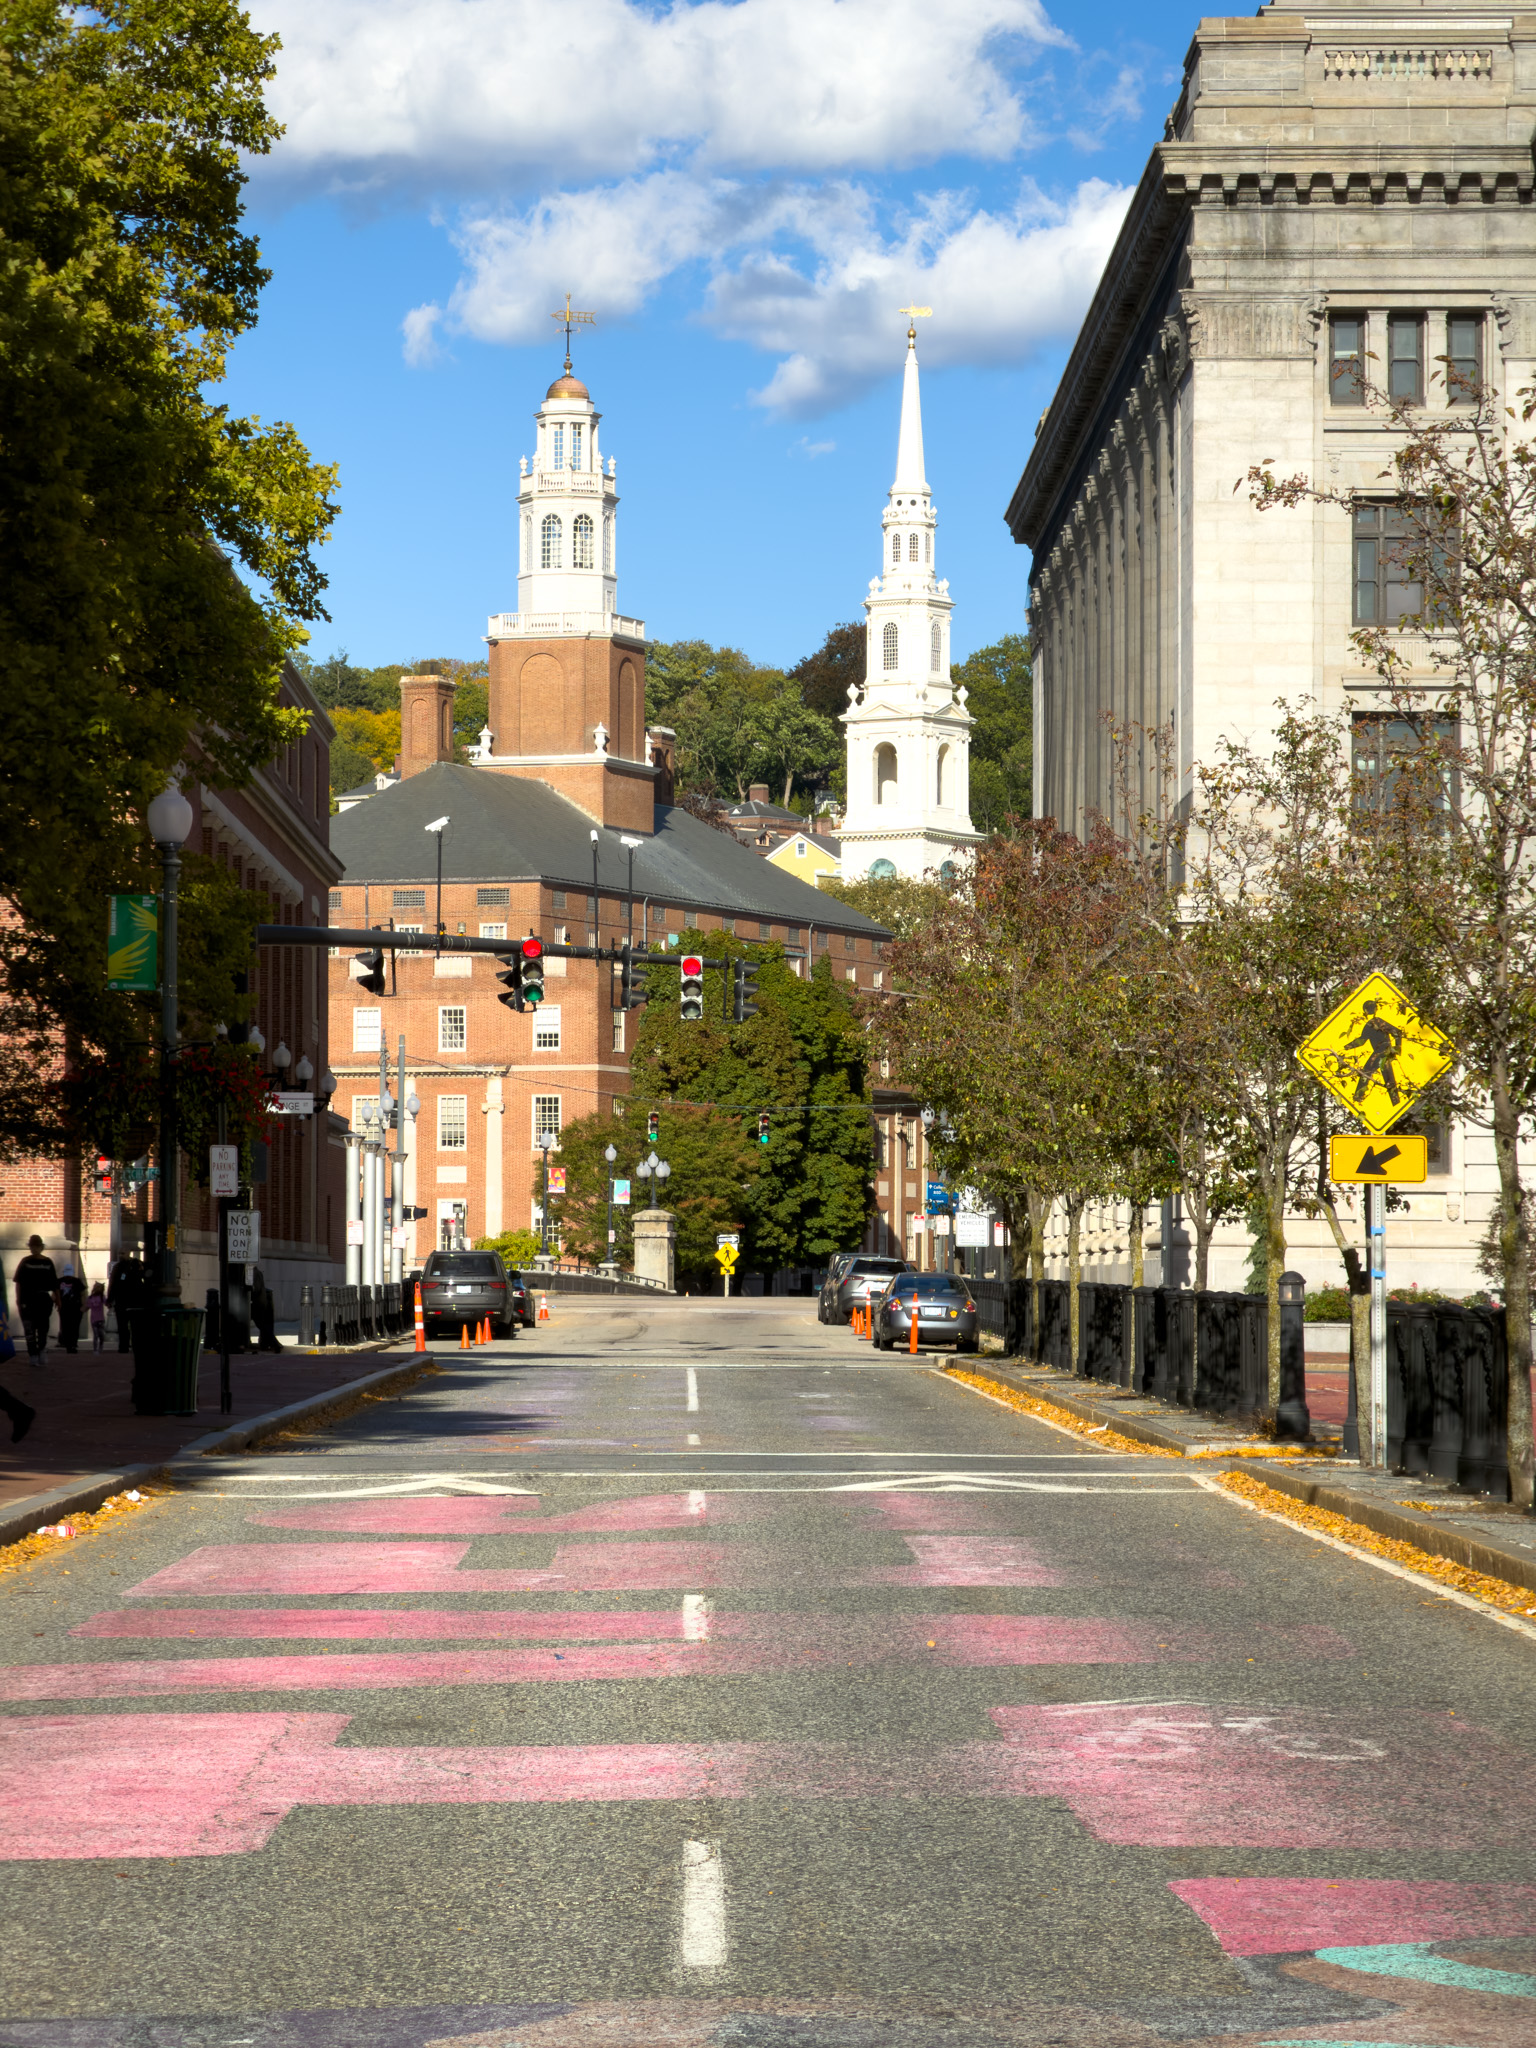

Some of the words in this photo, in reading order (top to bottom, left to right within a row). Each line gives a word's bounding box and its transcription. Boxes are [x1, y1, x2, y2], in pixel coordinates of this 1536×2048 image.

[218, 1151, 229, 1161] NO
[212, 1162, 236, 1172] PARKING
[230, 1216, 249, 1226] NO
[228, 1228, 252, 1237] TURN
[232, 1239, 246, 1248] ON
[230, 1250, 249, 1259] RED
